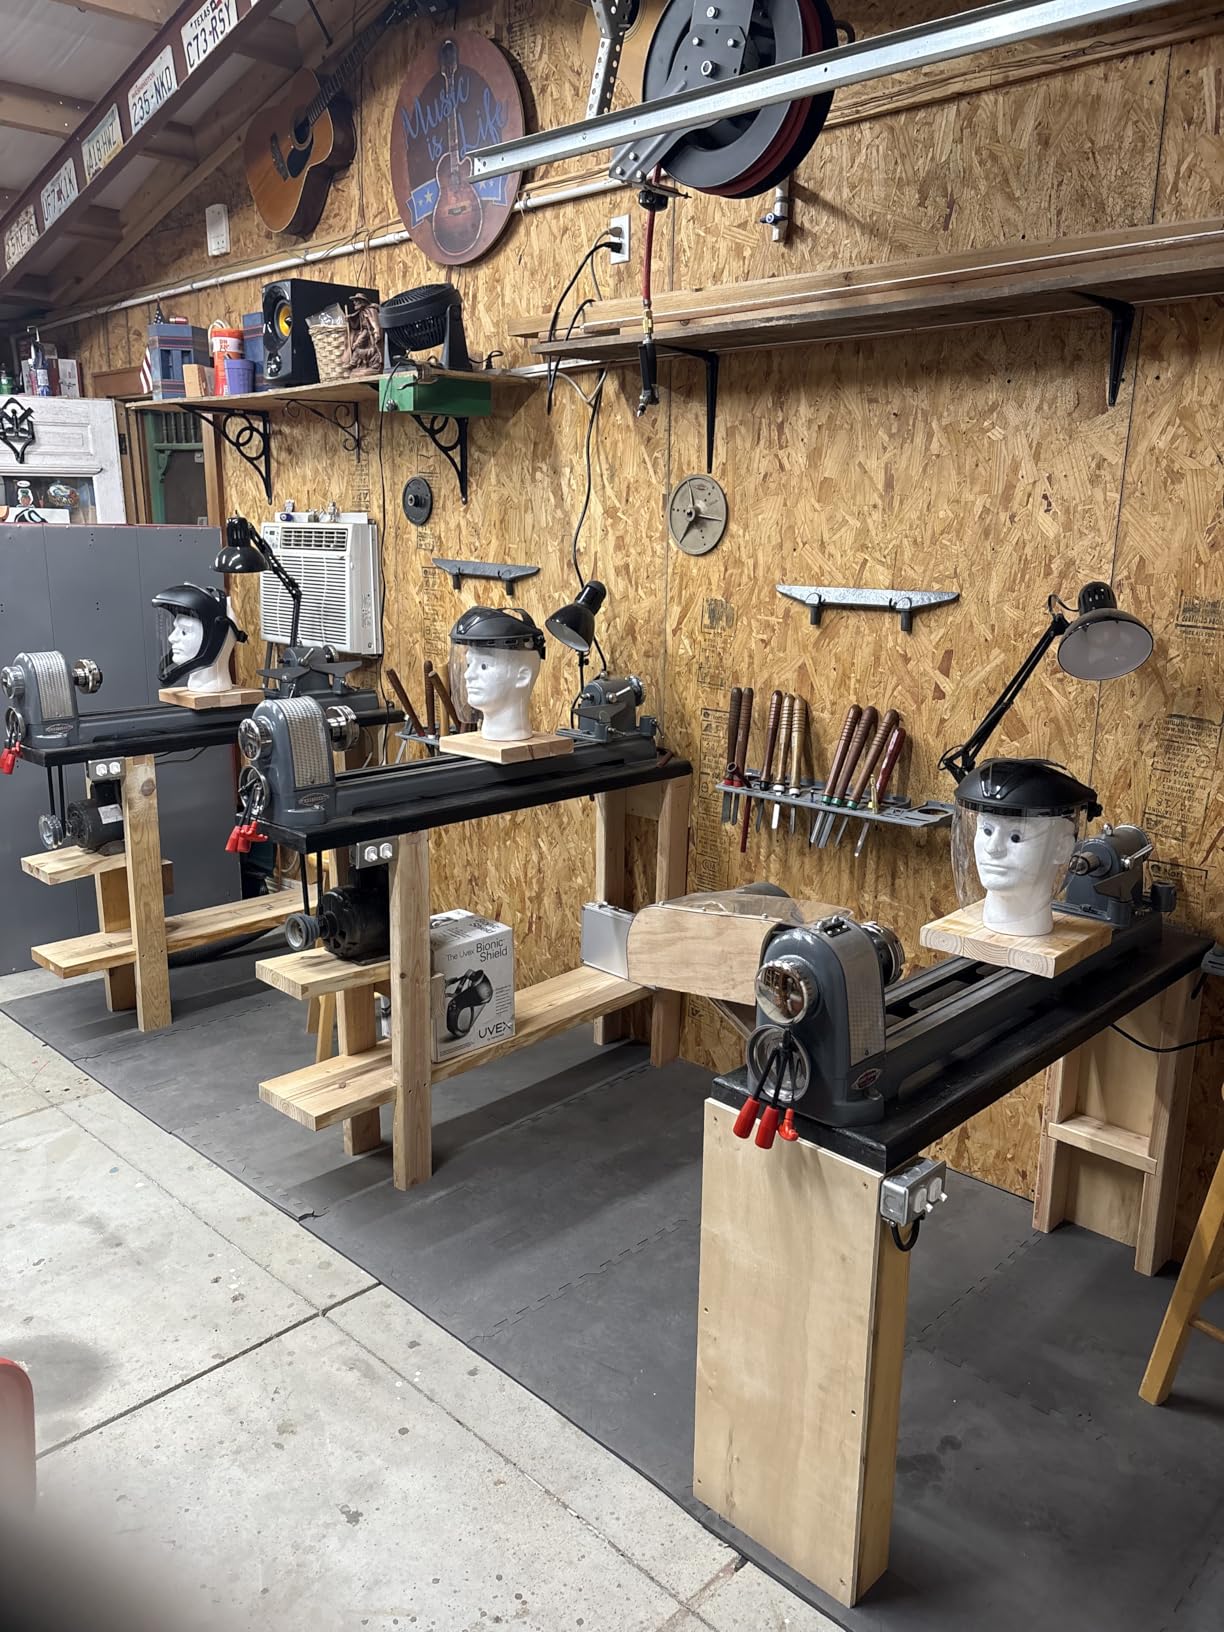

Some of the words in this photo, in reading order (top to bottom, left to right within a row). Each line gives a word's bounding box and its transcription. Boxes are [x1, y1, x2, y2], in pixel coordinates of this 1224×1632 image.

[193, 8, 211, 30] TEXAS
[401, 77, 471, 142] Music
[427, 136, 444, 162] is
[459, 88, 510, 157] Life
[446, 951, 458, 962] The
[460, 948, 474, 959] Uvex
[476, 938, 503, 954] Bionic
[480, 945, 508, 963] Shield
[478, 1021, 511, 1039] UVEX
